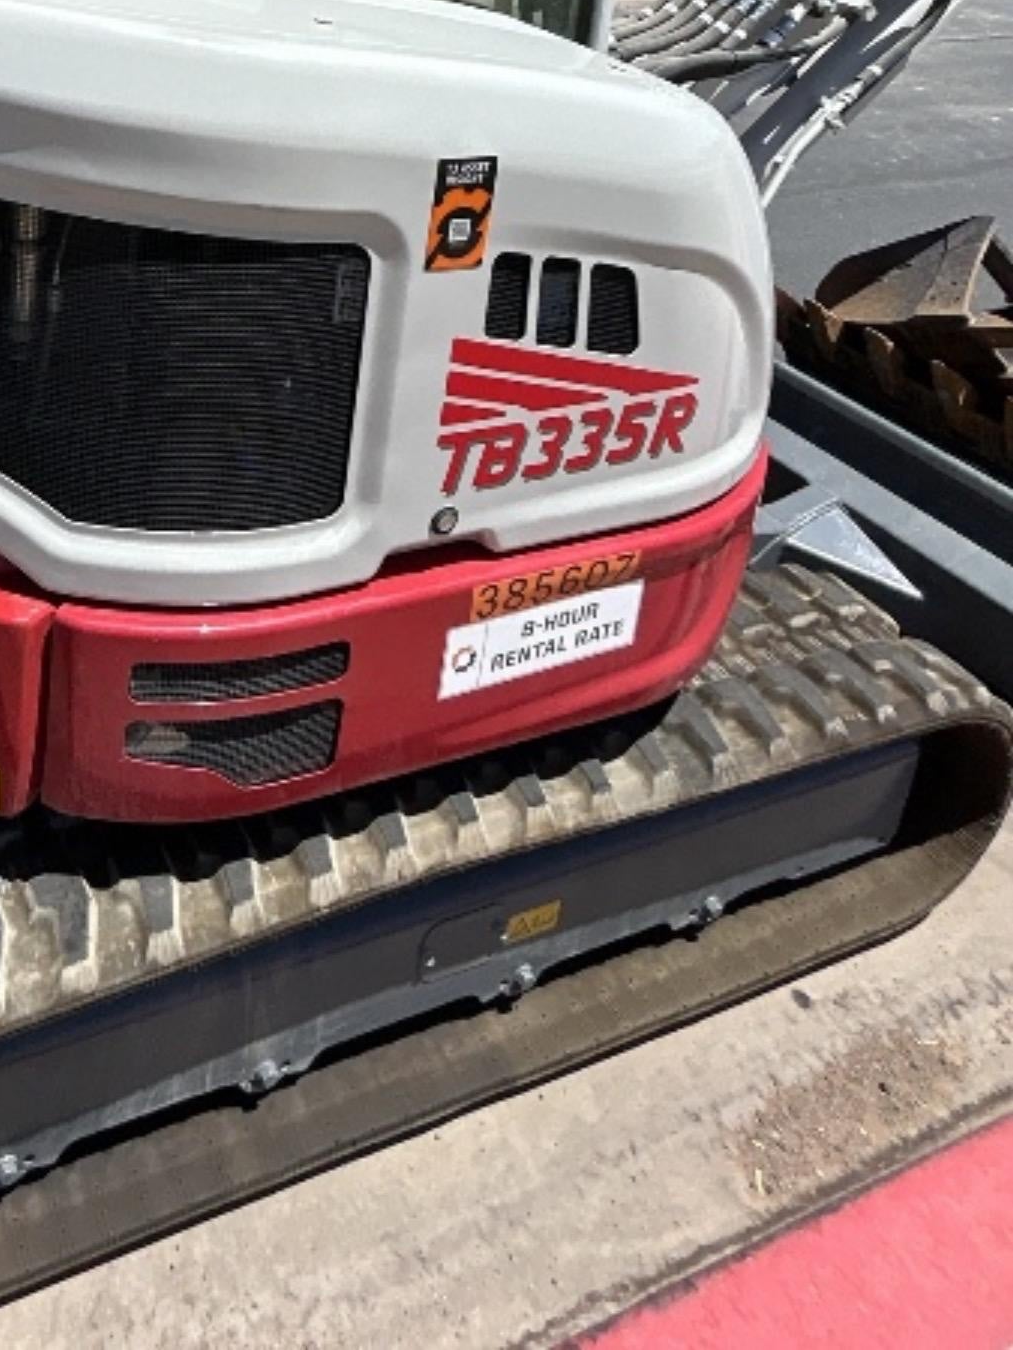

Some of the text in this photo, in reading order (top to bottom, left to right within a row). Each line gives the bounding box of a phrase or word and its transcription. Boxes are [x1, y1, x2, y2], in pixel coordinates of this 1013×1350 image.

[436, 391, 699, 496] TB335R
[520, 601, 600, 638] 8-HOUR
[489, 620, 625, 673] RENTAL RATE
